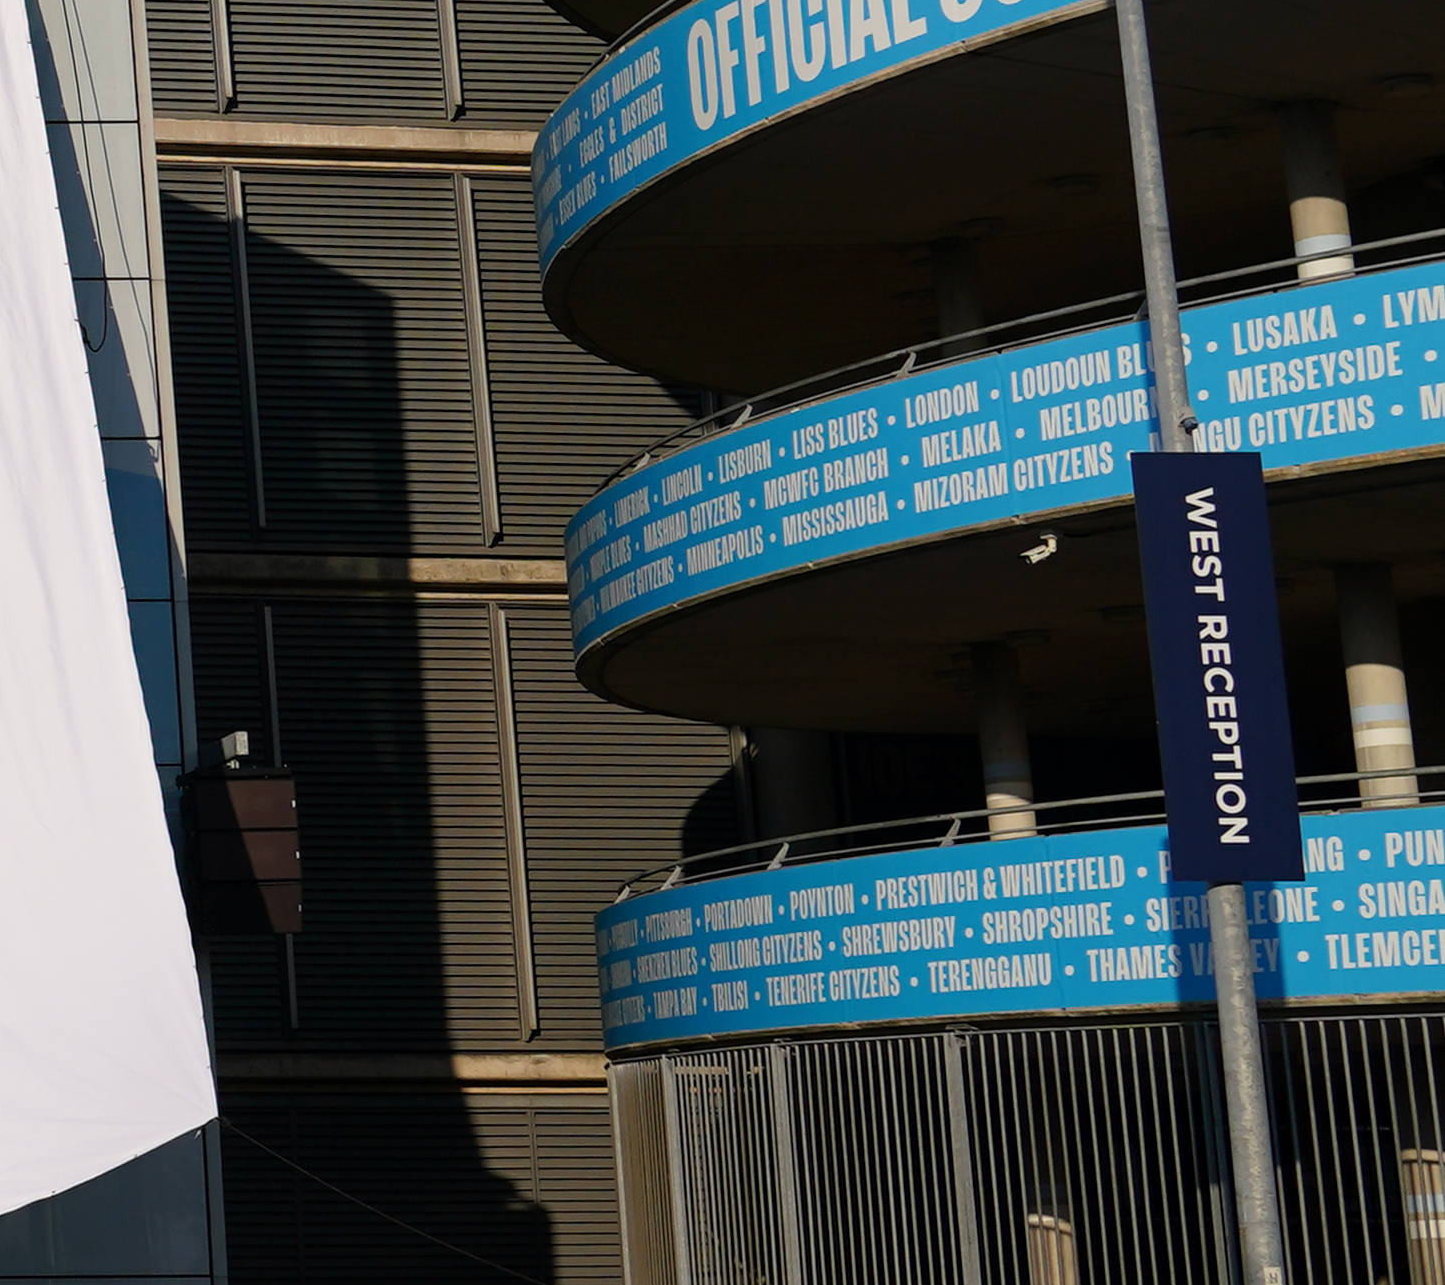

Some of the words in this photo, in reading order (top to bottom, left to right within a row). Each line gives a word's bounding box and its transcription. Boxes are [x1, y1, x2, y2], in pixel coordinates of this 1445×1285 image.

[591, 80, 611, 120] EAST
[612, 46, 661, 104] MIDLANDS
[620, 83, 665, 136] DISTRICT
[608, 121, 668, 183] FAILSWORTH
[661, 464, 703, 506] LINCOLN
[718, 438, 772, 484] LISBURN
[792, 423, 825, 460] LISS
[827, 407, 879, 450] BLUES
[904, 381, 980, 428] LONDON
[1010, 349, 1112, 403] LOUDOUN
[1231, 304, 1338, 356] LUSAKA
[643, 510, 689, 553] MASHHAD
[689, 490, 742, 535] CITYZENS
[763, 466, 820, 511] MCWFC
[823, 447, 889, 493] BRANCH
[921, 420, 1002, 468] MELAKA
[1227, 340, 1404, 404] MERSEYSIDE
[686, 524, 764, 577] MINNEAPOLIS
[781, 490, 889, 547] MISSISSAUGA
[913, 462, 1009, 513] MIZORAM
[1013, 440, 1115, 492] CITYZENS
[1248, 394, 1376, 448] CITYZENS
[1184, 486, 1226, 603] WEST
[1197, 614, 1251, 845] RECEPTION
[704, 894, 774, 933] PORTADOWN
[789, 882, 855, 921] POYNTON
[875, 869, 979, 910] PRESTWICH
[982, 867, 998, 900] &
[999, 854, 1126, 898] WHITEFIELD
[709, 938, 762, 973] SHILLONG
[762, 929, 823, 966] CITYZENS
[841, 915, 956, 958] SHREWSBURY
[981, 901, 1114, 945] SHROPSHIRE
[711, 980, 750, 1013] TBILISI
[766, 972, 827, 1007] TENERIFE
[827, 964, 901, 1002] CITYZENS
[927, 952, 1053, 995] TERENGGANU
[1086, 945, 1183, 983] THAMES
